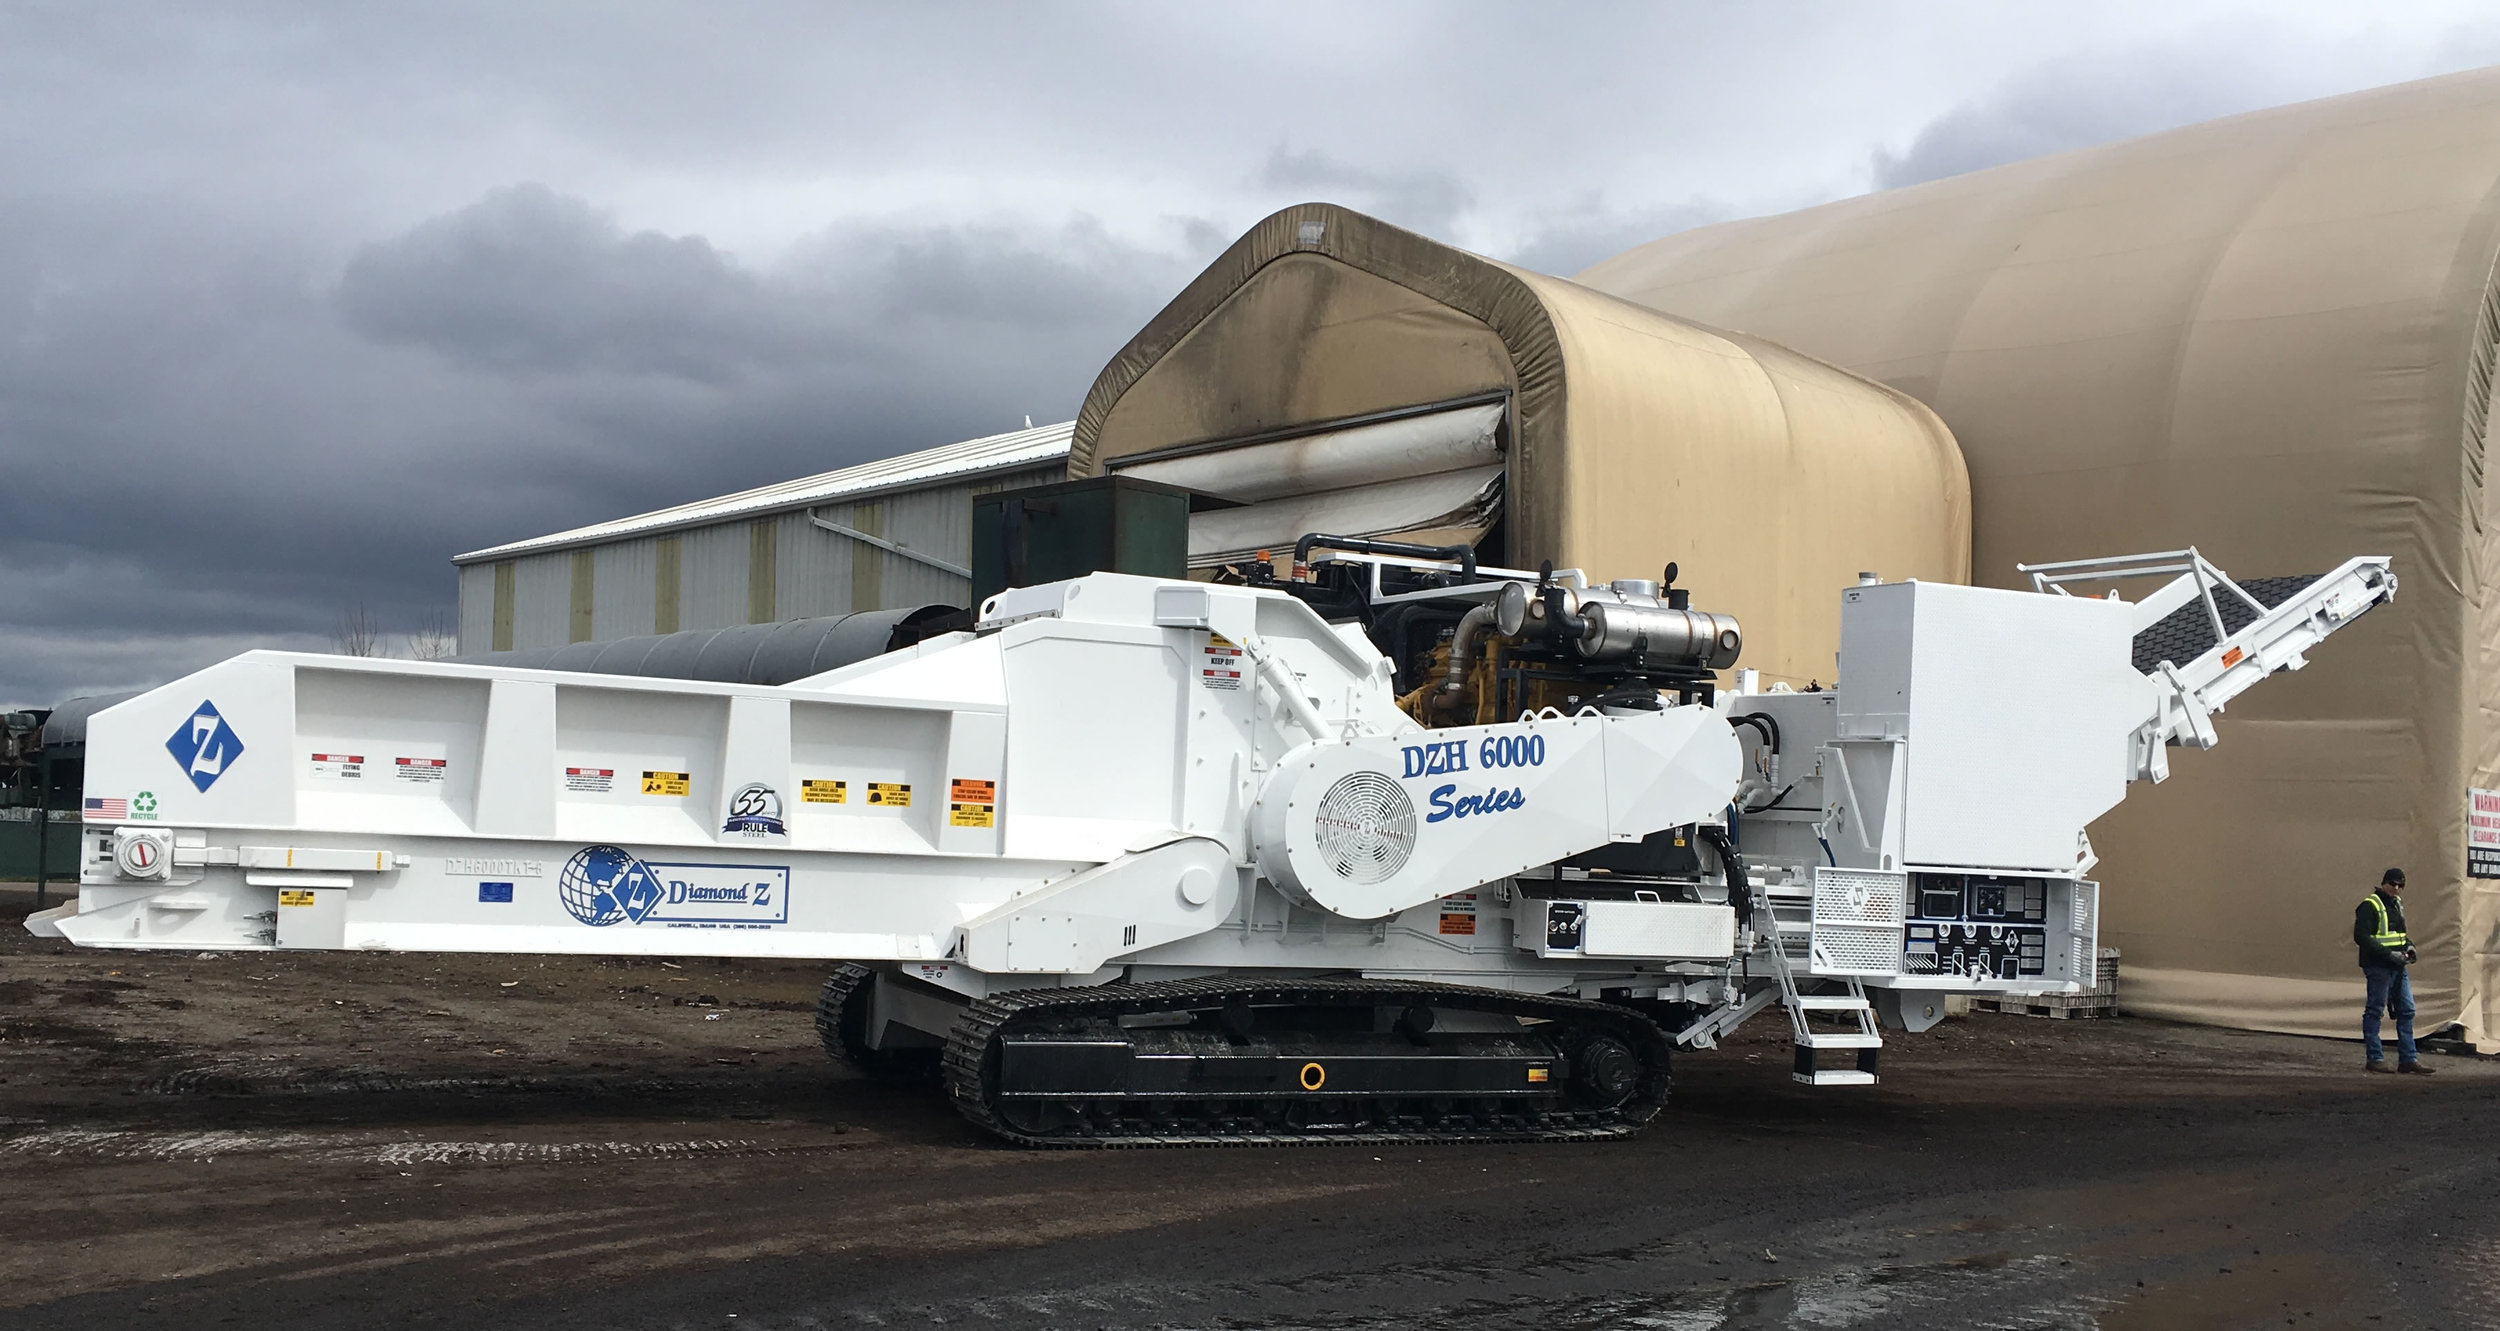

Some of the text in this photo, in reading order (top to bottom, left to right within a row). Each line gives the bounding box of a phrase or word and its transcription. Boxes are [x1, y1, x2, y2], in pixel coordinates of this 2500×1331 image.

[189, 714, 224, 776] Z
[1401, 734, 1545, 779] DZH 6000
[654, 772, 678, 780] CAUTION
[731, 790, 776, 816] 55
[961, 804, 984, 812] CAUTION
[1426, 784, 1526, 823] Series
[2474, 794, 2500, 813] WARNIN
[743, 822, 768, 832] RULE
[2470, 815, 2491, 828] MAXIMUM
[2474, 830, 2497, 844] CLEARANCE
[627, 872, 646, 910] Z
[666, 880, 770, 906] Diamond Z
